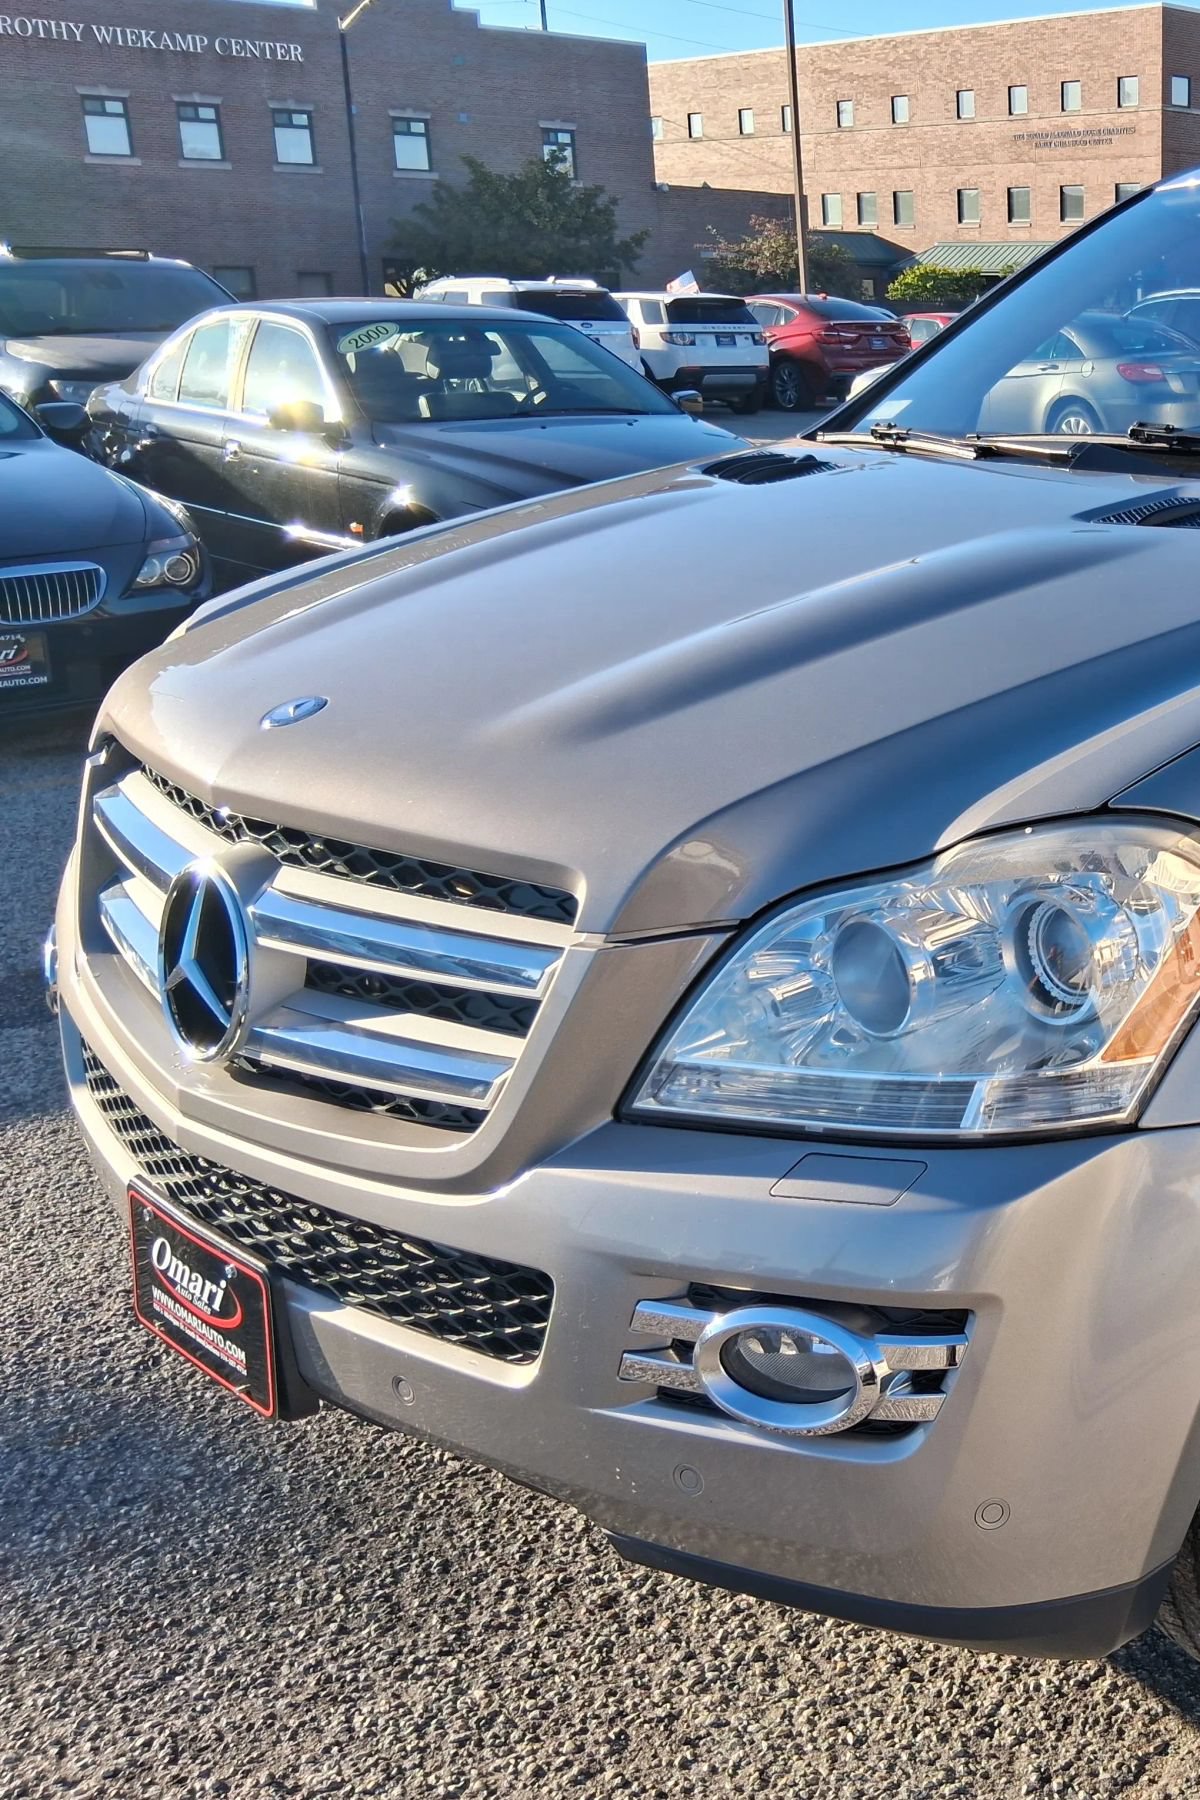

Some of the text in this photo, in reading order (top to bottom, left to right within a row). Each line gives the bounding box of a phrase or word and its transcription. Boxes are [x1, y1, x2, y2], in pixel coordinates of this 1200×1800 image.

[90, 24, 208, 53] WIEKAMP
[214, 37, 304, 62] CENTER
[348, 325, 389, 349] 2000
[152, 1237, 227, 1312] Omari
[151, 1285, 247, 1364] WWW.OMARIAUTO.COM
